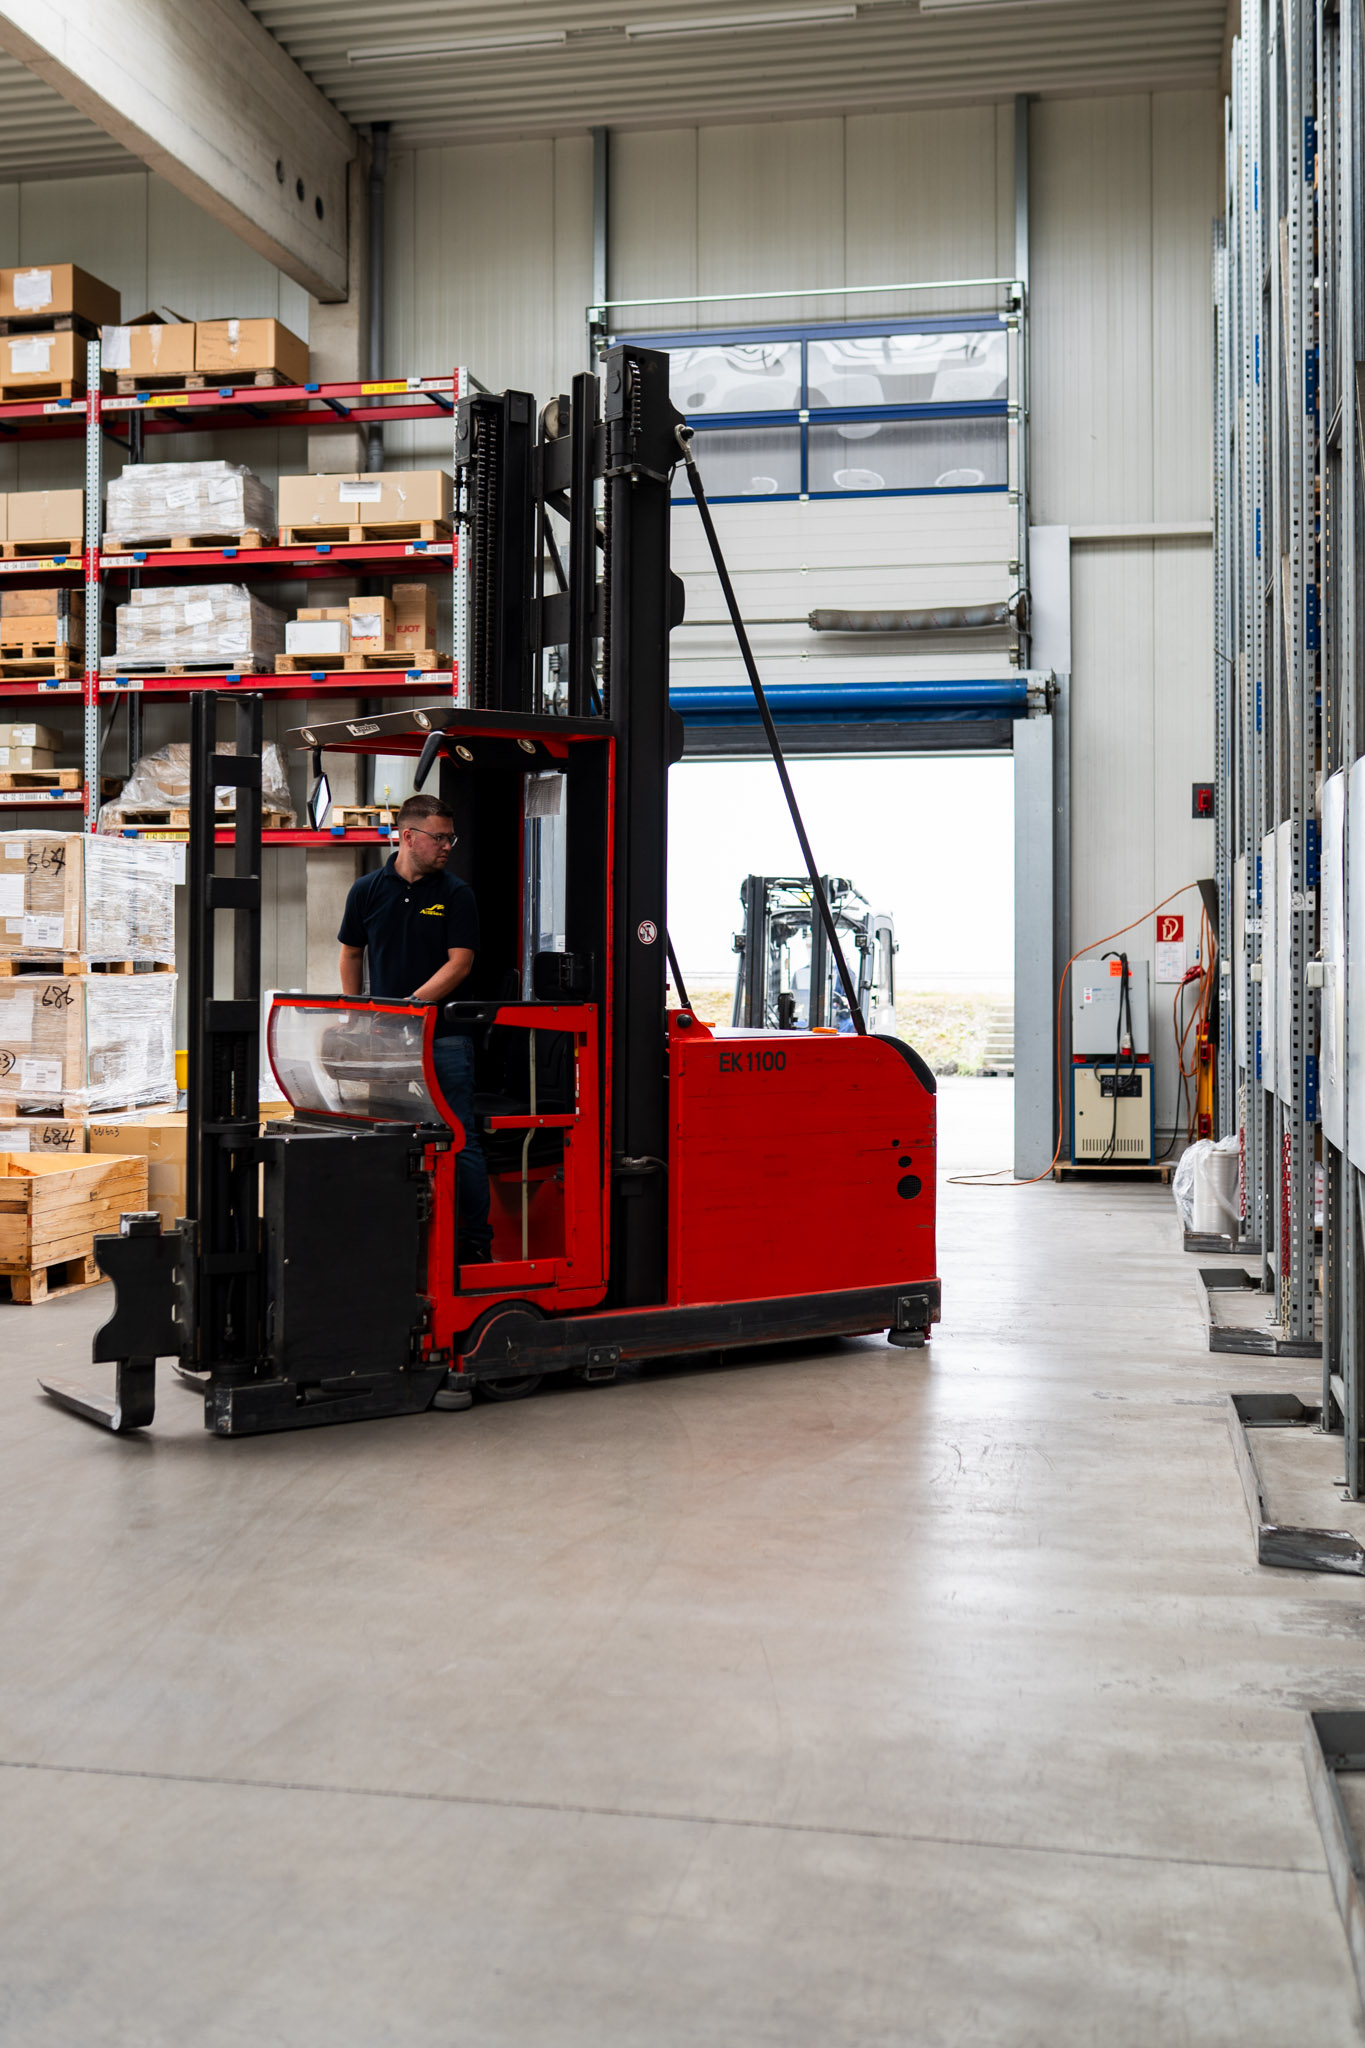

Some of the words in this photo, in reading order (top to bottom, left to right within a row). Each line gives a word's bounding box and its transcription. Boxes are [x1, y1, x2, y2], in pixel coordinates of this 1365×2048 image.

[396, 625, 421, 633] EJOT
[719, 1052, 743, 1072] EK
[746, 1051, 786, 1072] 1100
[43, 1126, 76, 1151] 684
